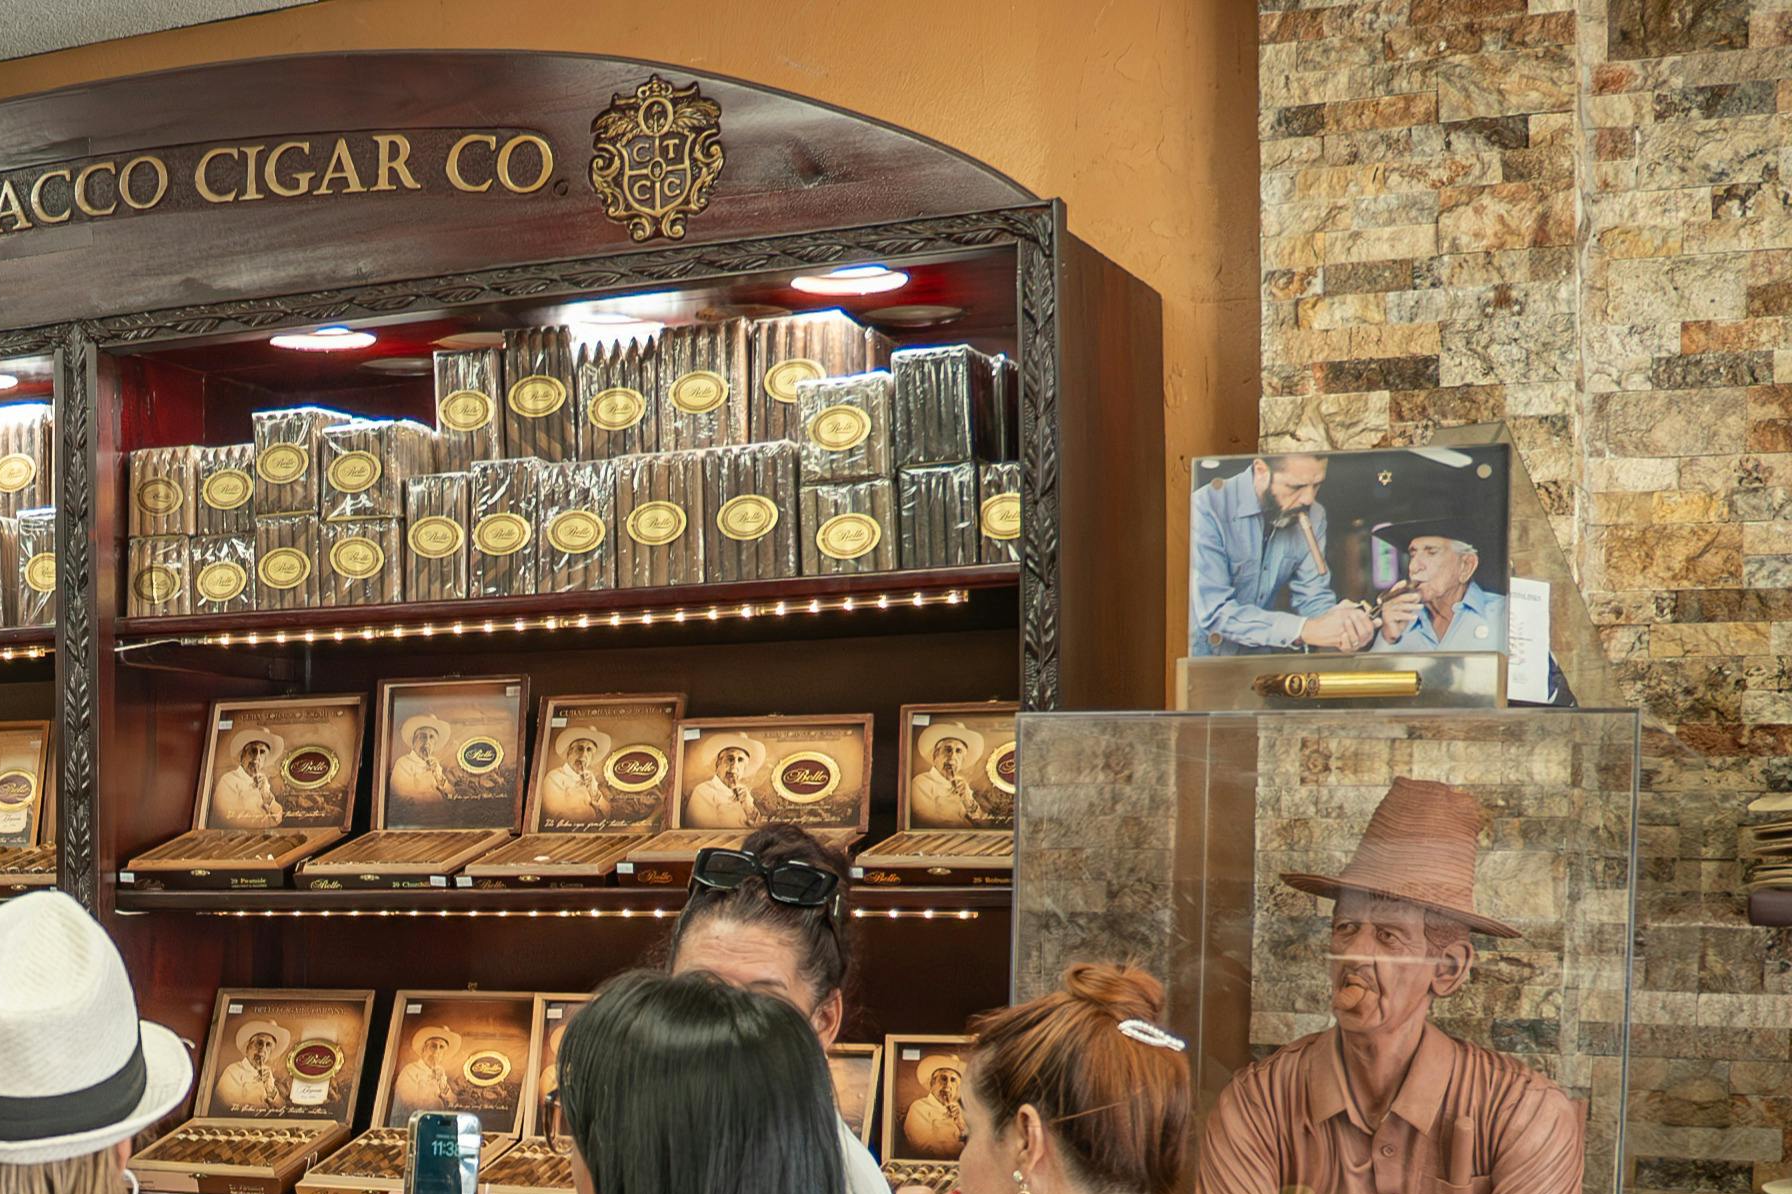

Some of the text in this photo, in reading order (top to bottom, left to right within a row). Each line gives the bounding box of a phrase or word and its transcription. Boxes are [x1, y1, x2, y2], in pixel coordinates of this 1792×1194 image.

[633, 139, 679, 162] C T
[194, 133, 421, 203] CIGAR
[445, 133, 554, 194] CO
[634, 178, 680, 199] C C
[614, 759, 657, 776] Bello
[783, 768, 829, 786] Bello
[638, 869, 673, 884] Bello
[864, 871, 901, 884] Bello
[296, 1053, 335, 1069] Bello
